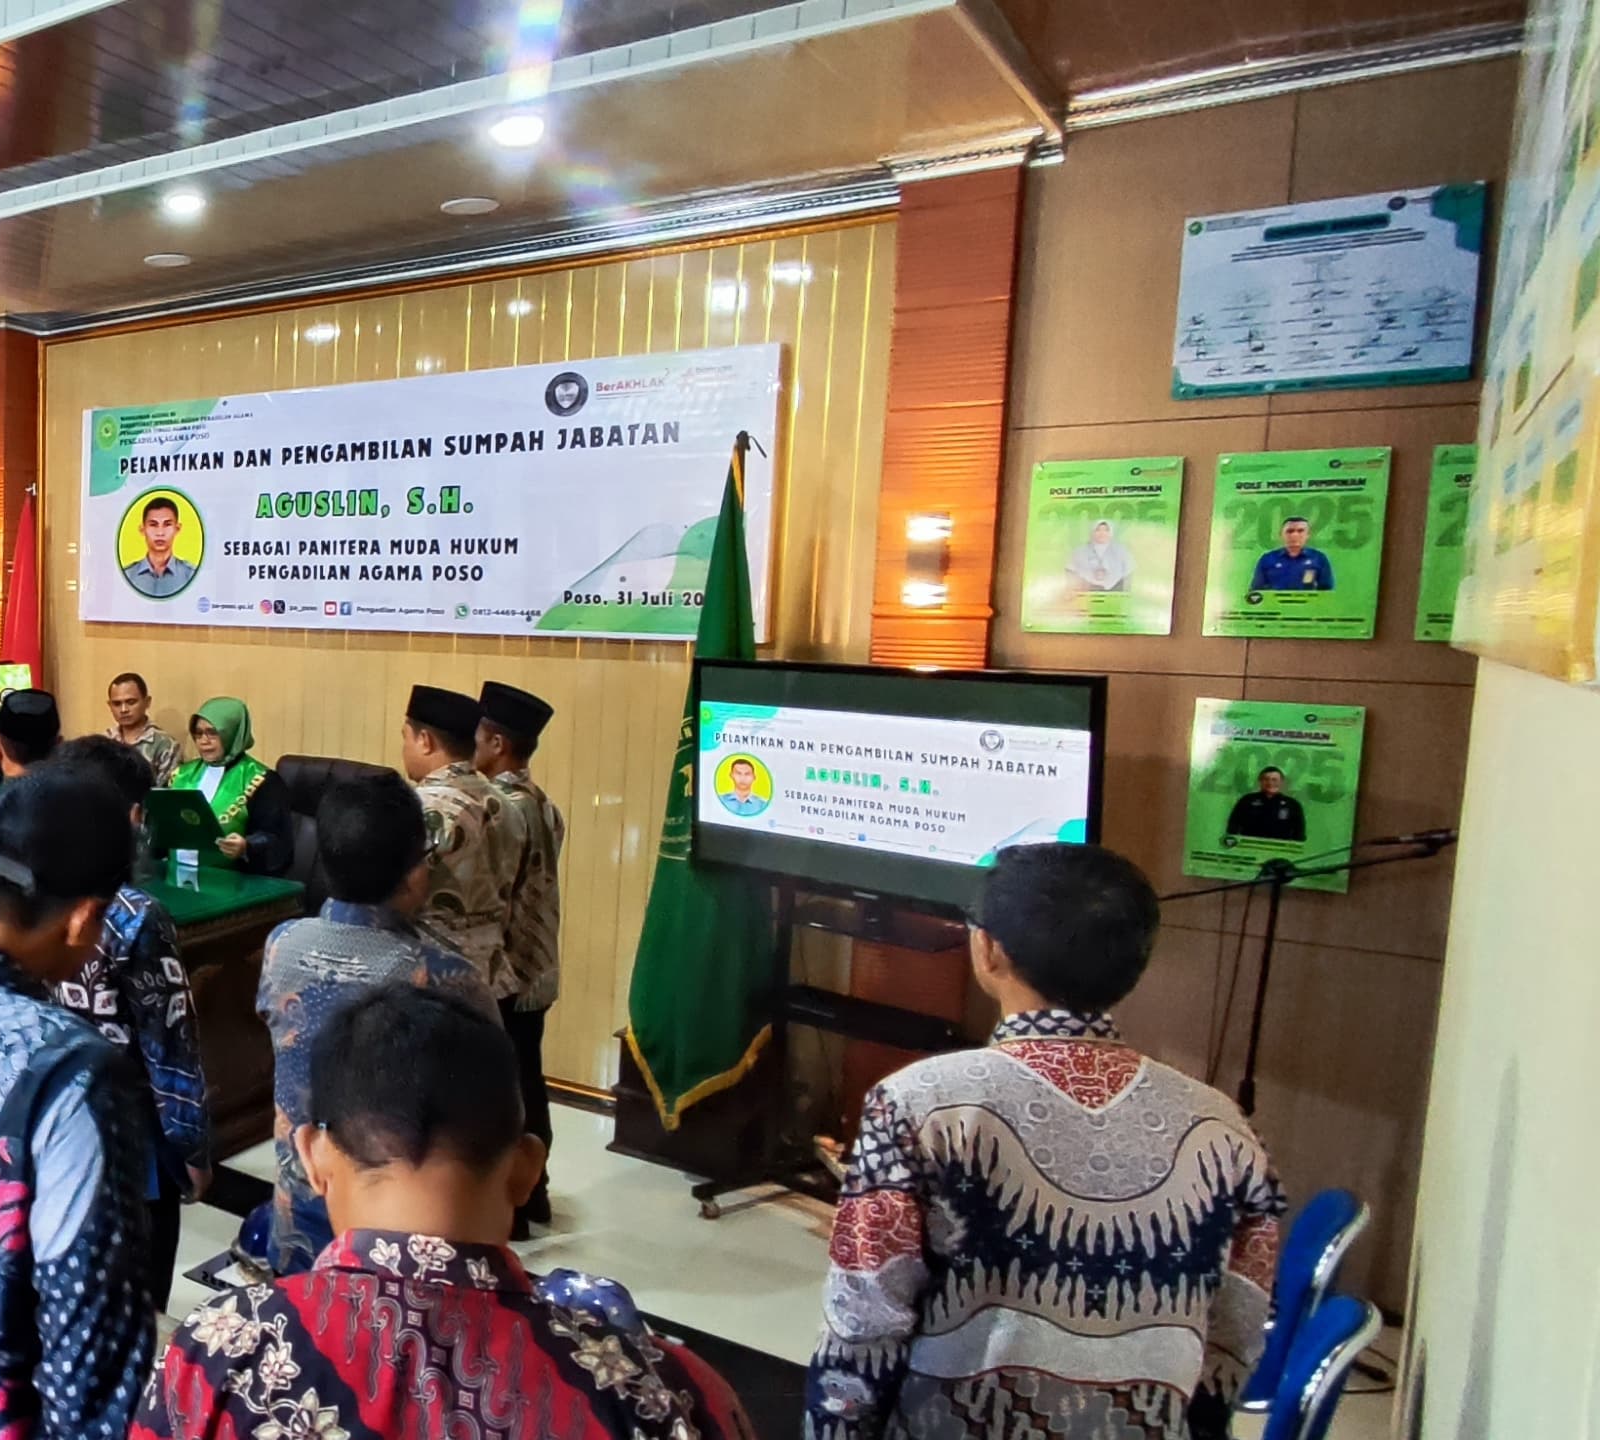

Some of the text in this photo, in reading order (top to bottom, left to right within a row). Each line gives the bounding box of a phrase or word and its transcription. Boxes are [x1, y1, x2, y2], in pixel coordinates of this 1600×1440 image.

[596, 378, 665, 392] BerAKHLAK
[120, 421, 681, 475] PELANTIKAN DAN PENGAMBILAN SUMPAH JABATAN
[256, 485, 474, 519] AGUSLIN, S.H.
[224, 538, 519, 556] SEBAGAI PANITERA MUDA HUKUM
[249, 565, 484, 581] PENGADILAN AGAMA POSO
[356, 605, 445, 616] Pengadilan Agama Poso
[617, 591, 633, 605] 31
[641, 591, 673, 606] Juli
[682, 592, 704, 606] 20
[715, 732, 1058, 777] PELANTIKAN DAN PENGAMBILAN SUMPAH JABATAN
[805, 766, 889, 791] AGUSLIN,
[784, 790, 966, 822] SEBAGAI PANITERA MUDA HUKUM
[800, 805, 945, 834] PENGADILAN AGAMA POSO
